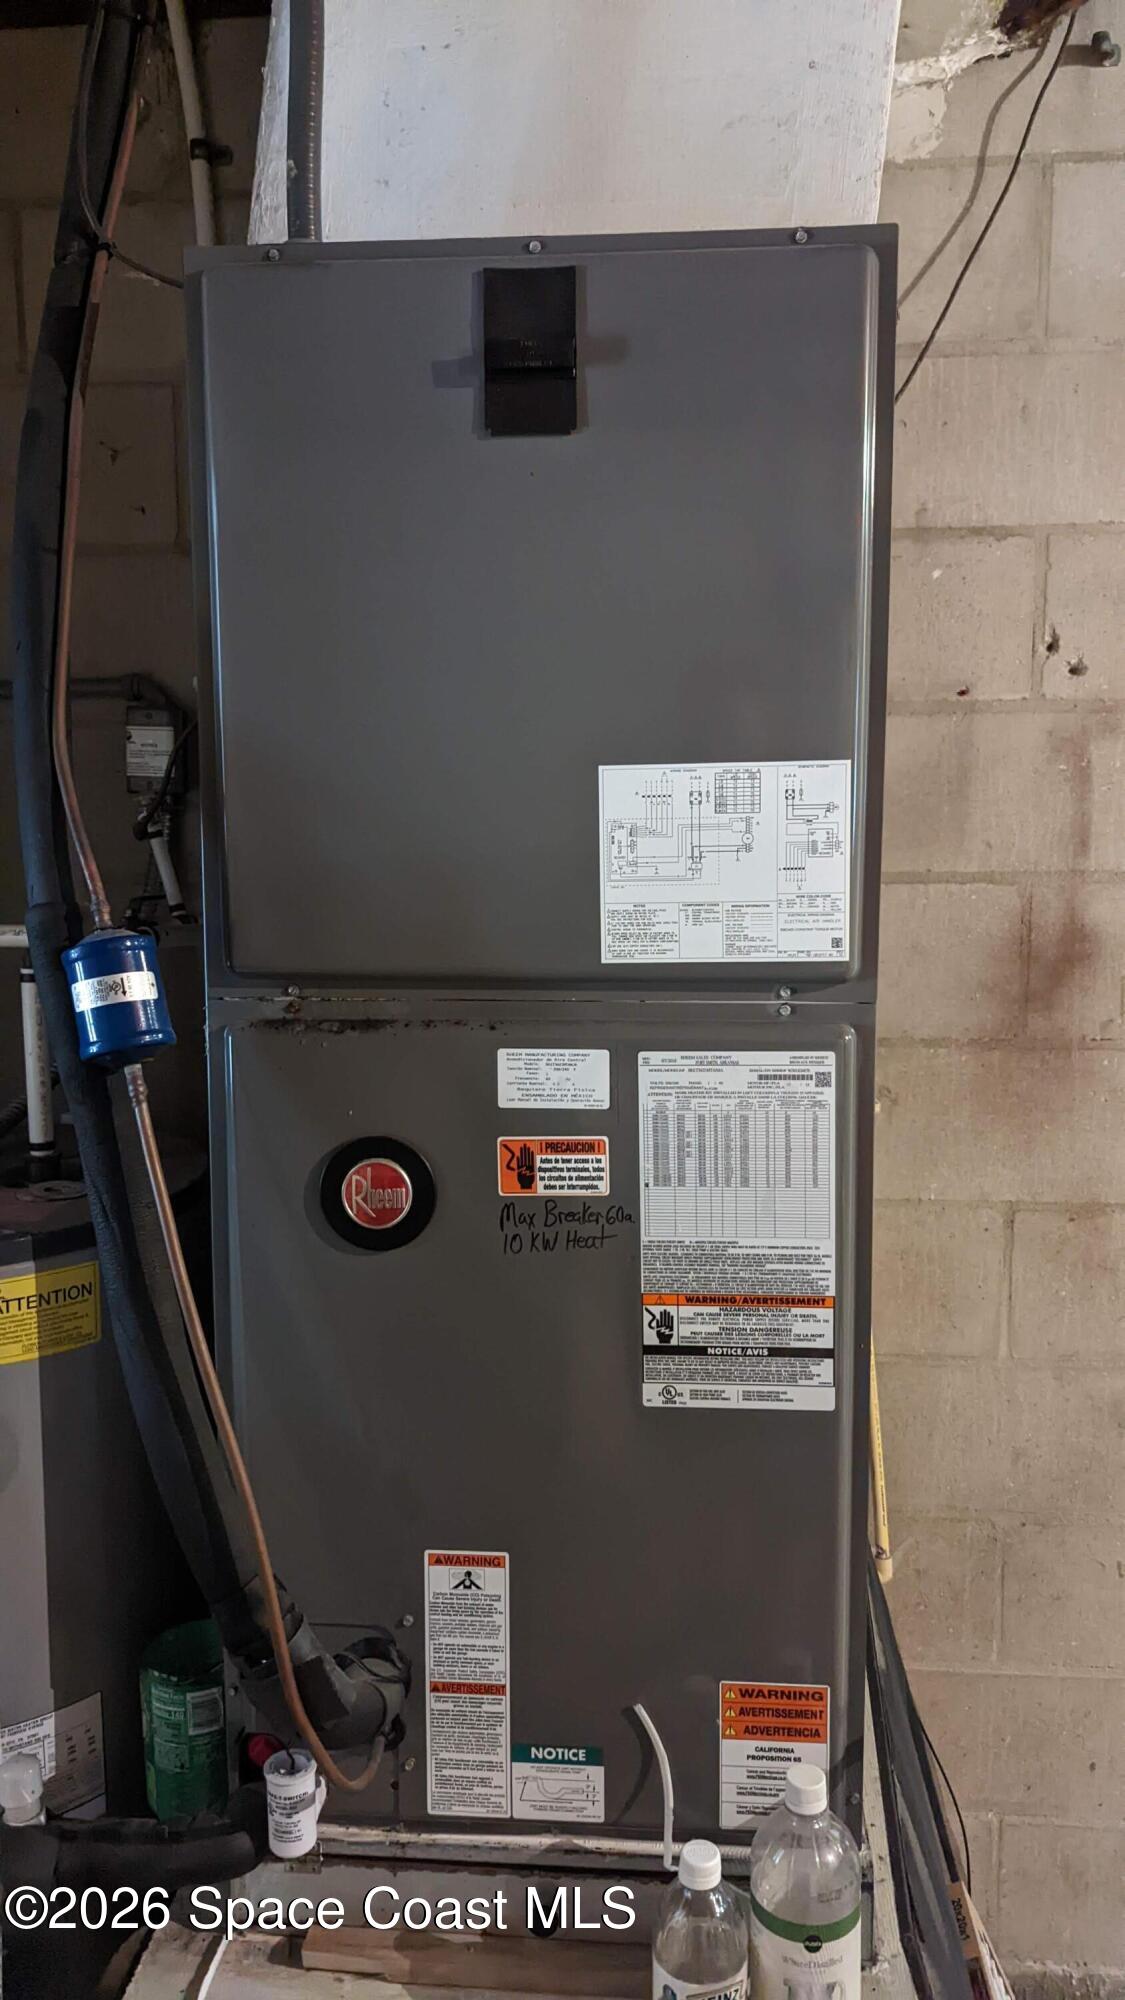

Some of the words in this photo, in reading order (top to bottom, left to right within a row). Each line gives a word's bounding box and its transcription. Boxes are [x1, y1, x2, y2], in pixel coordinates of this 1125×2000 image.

[545, 1142, 595, 1153] PRECAUCION
[351, 1167, 406, 1218] Rheem
[500, 1201, 536, 1232] Max
[543, 1199, 604, 1227] Breaker
[504, 1233, 523, 1255] 10
[566, 1223, 618, 1251] Heat
[685, 1296, 826, 1306] WARNING/AVERTISSEMENT
[707, 1347, 769, 1356] NOTICE/AVIS
[665, 1388, 672, 1397] UL
[443, 1556, 501, 1567] WARNING
[441, 1683, 506, 1696] AVERTISSEMENT
[738, 1688, 824, 1701] WARNING
[738, 1706, 824, 1719] AVERTISSEMENT
[743, 1724, 821, 1738] ADVERTENCIA
[530, 1746, 587, 1762] NOTICE
[755, 1746, 794, 1754] CALIFORNIA
[747, 1754, 792, 1762] PROPOSITION
